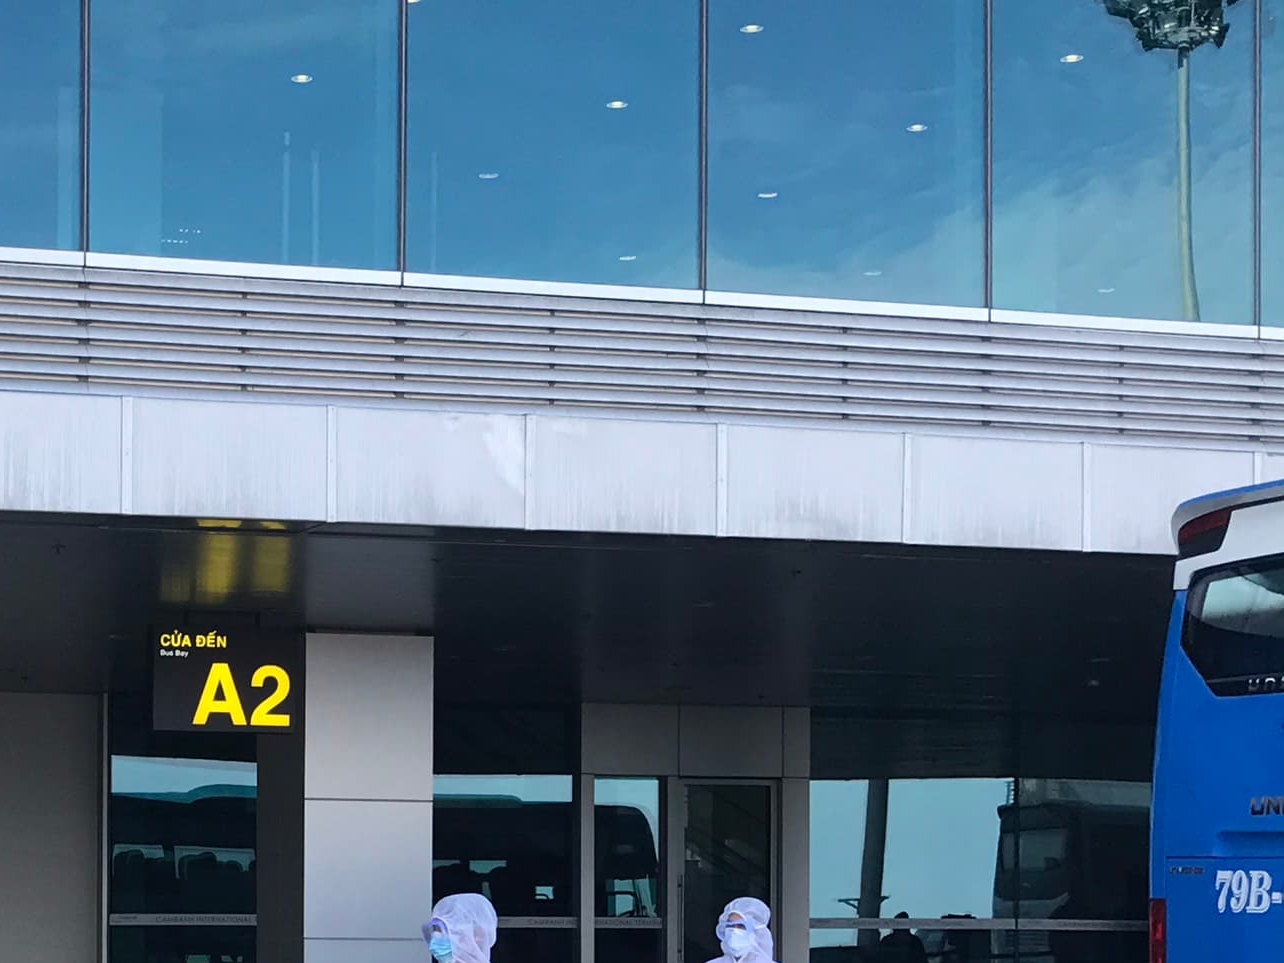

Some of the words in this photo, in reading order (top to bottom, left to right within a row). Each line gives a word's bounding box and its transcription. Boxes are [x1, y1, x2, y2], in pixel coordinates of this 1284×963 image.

[160, 629, 192, 648] CỬA
[195, 630, 227, 648] ĐẾN
[160, 649, 174, 657] Bus
[175, 649, 189, 658] Bay
[192, 662, 291, 727] A2
